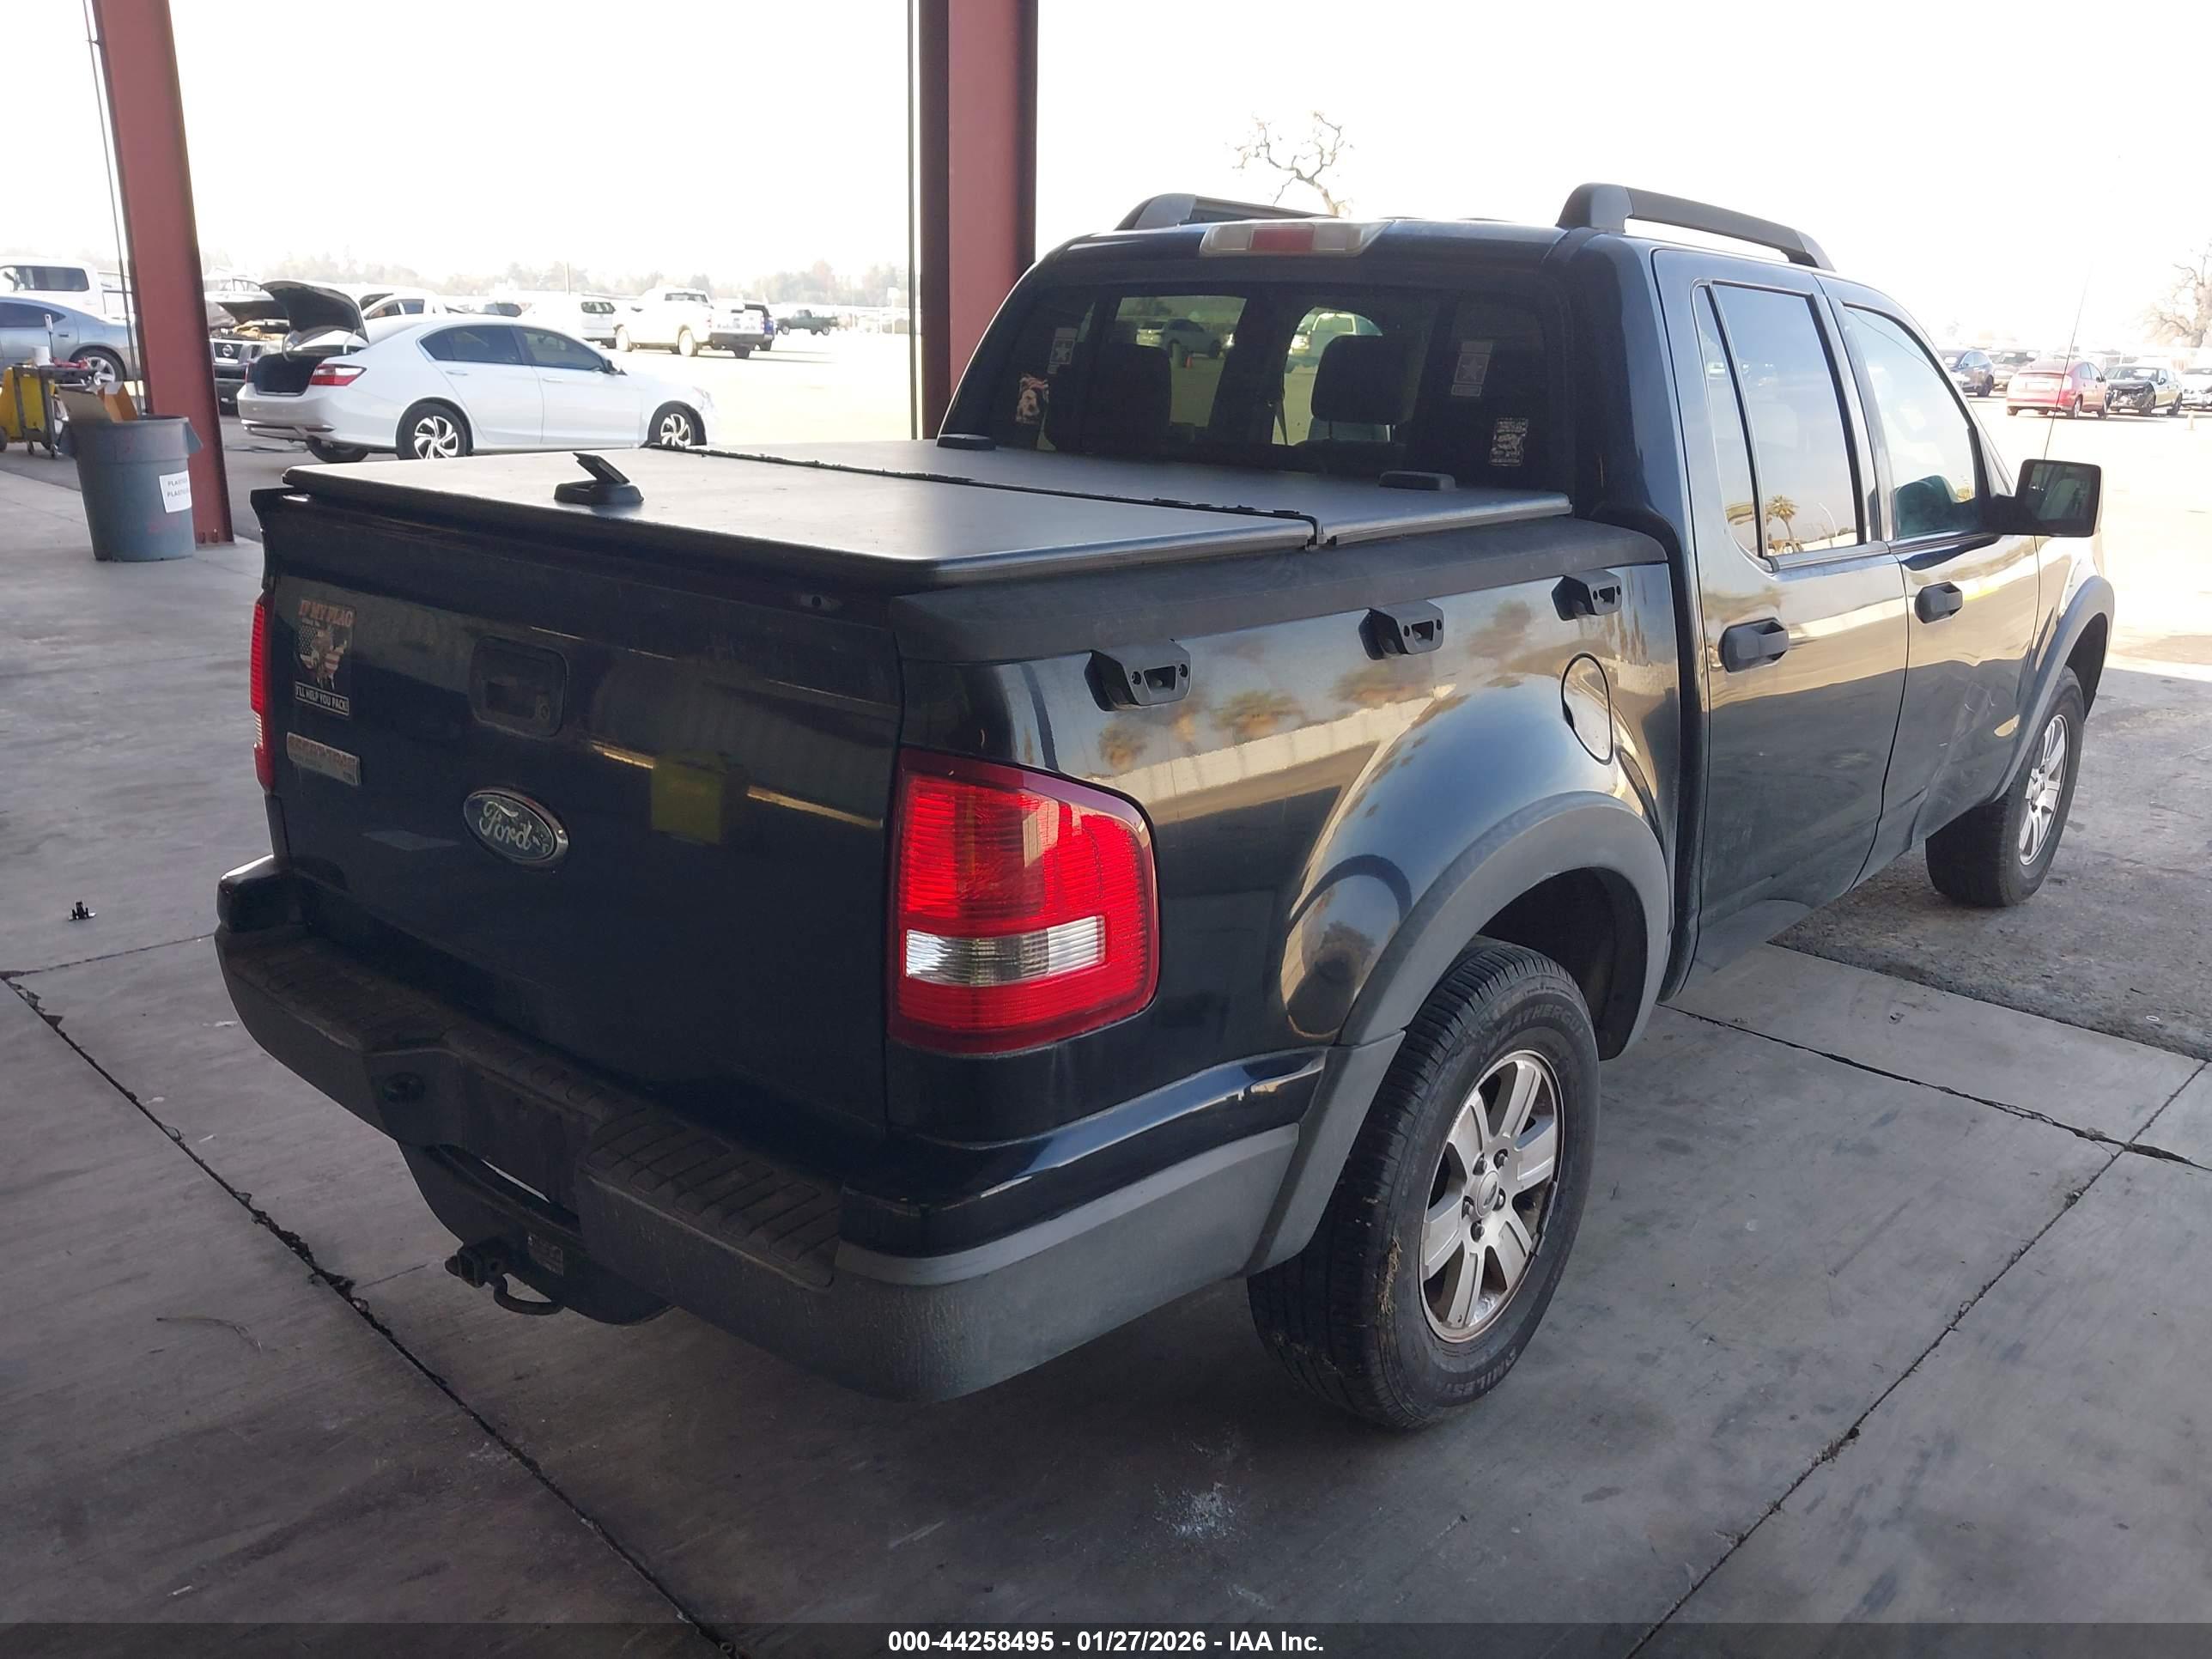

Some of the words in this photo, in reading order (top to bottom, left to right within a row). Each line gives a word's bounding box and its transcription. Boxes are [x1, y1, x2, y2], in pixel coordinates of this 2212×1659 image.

[306, 688, 319, 702] HELP
[319, 693, 331, 706] YOU
[479, 800, 532, 851] Ford
